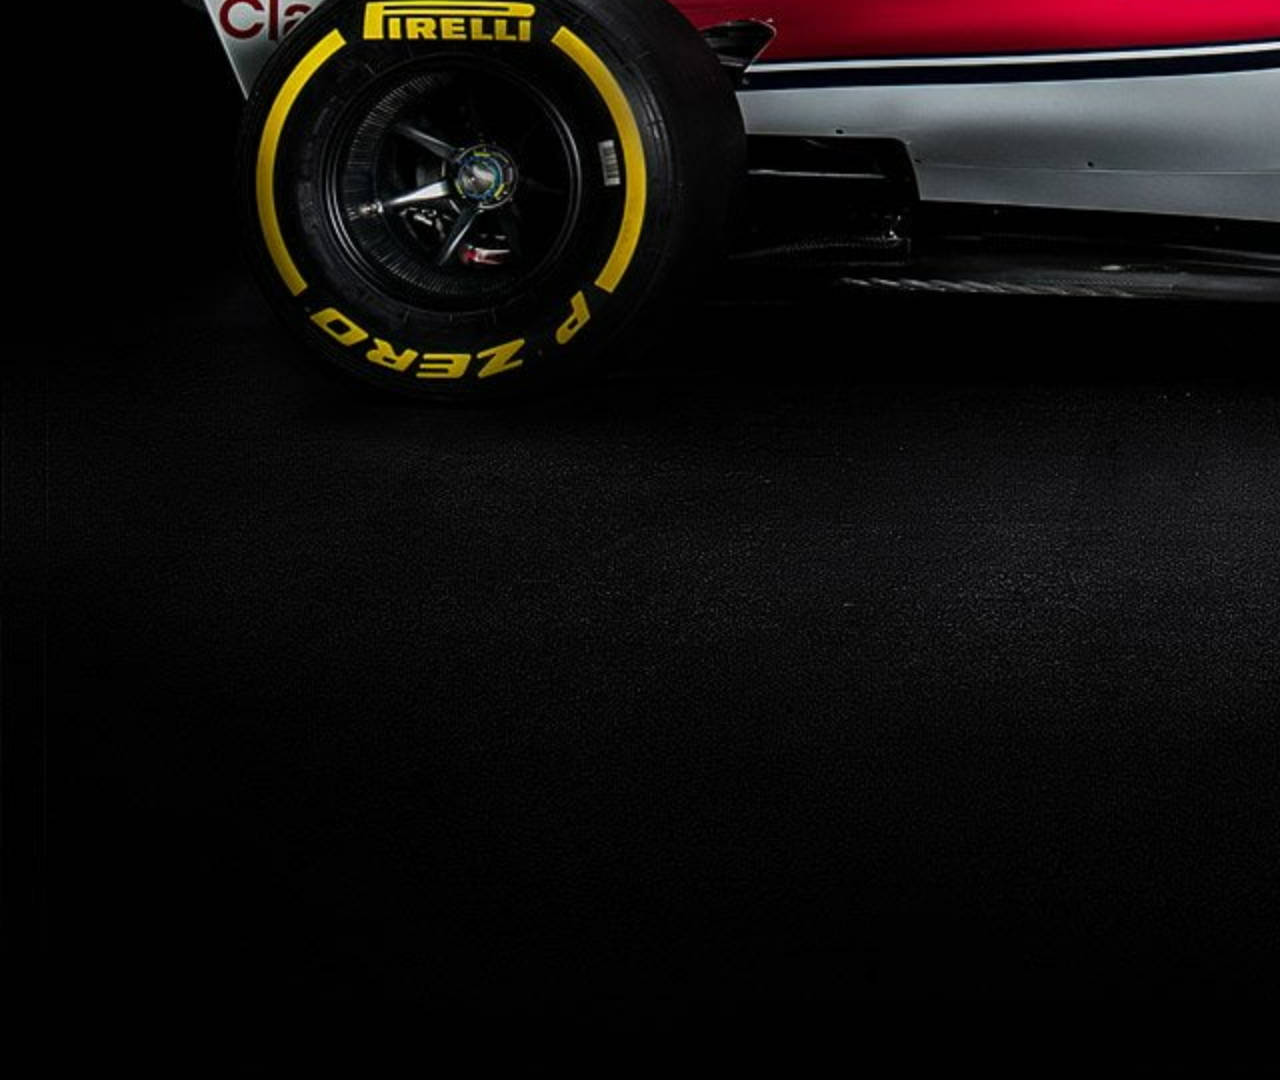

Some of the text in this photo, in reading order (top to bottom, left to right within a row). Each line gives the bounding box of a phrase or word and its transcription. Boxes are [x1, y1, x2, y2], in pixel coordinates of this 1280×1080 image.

[363, 0, 535, 41] PIRELLI
[310, 290, 591, 379] P ZERO
